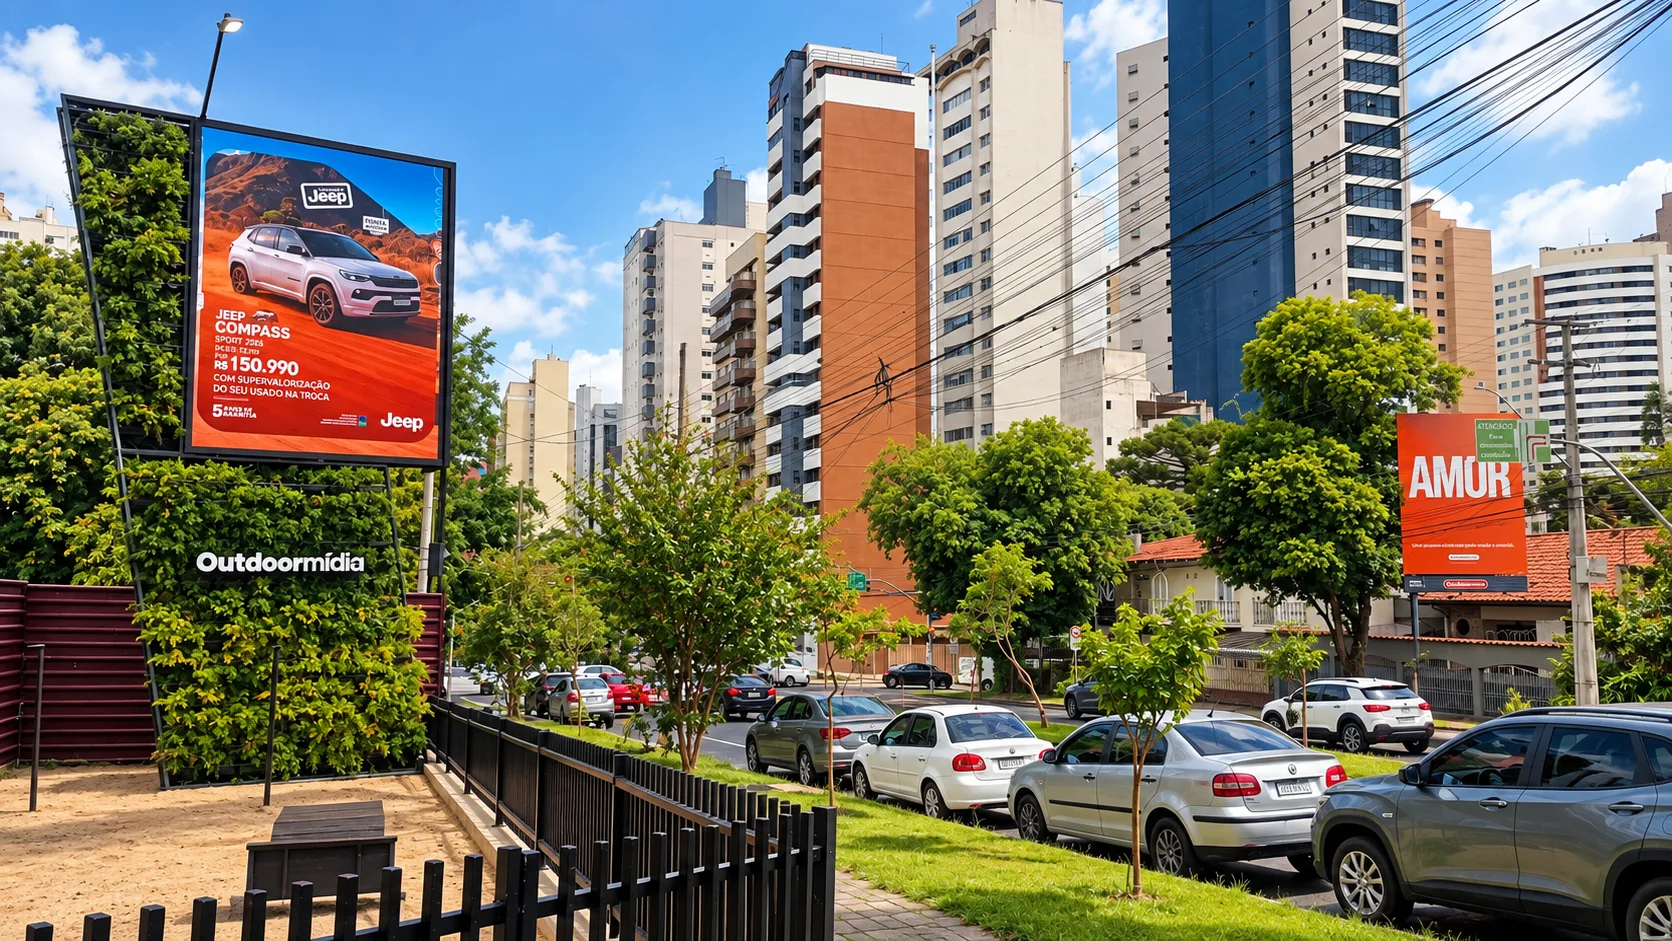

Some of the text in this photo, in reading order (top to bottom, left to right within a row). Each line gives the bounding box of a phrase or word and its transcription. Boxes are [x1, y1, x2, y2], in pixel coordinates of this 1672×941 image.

[308, 189, 347, 205] Jeep
[216, 309, 246, 321] JEEP
[215, 320, 291, 339] COMPASS
[214, 356, 299, 376] R$ 150.990
[213, 373, 331, 390] COM SUPERVALORIZAÇÃO
[213, 384, 330, 401] DO SEU USADO NA TROCA
[212, 404, 223, 417] 5
[381, 412, 424, 432] Jeep
[1409, 456, 1512, 498] AMOR
[196, 552, 365, 572] Outdoormídia
